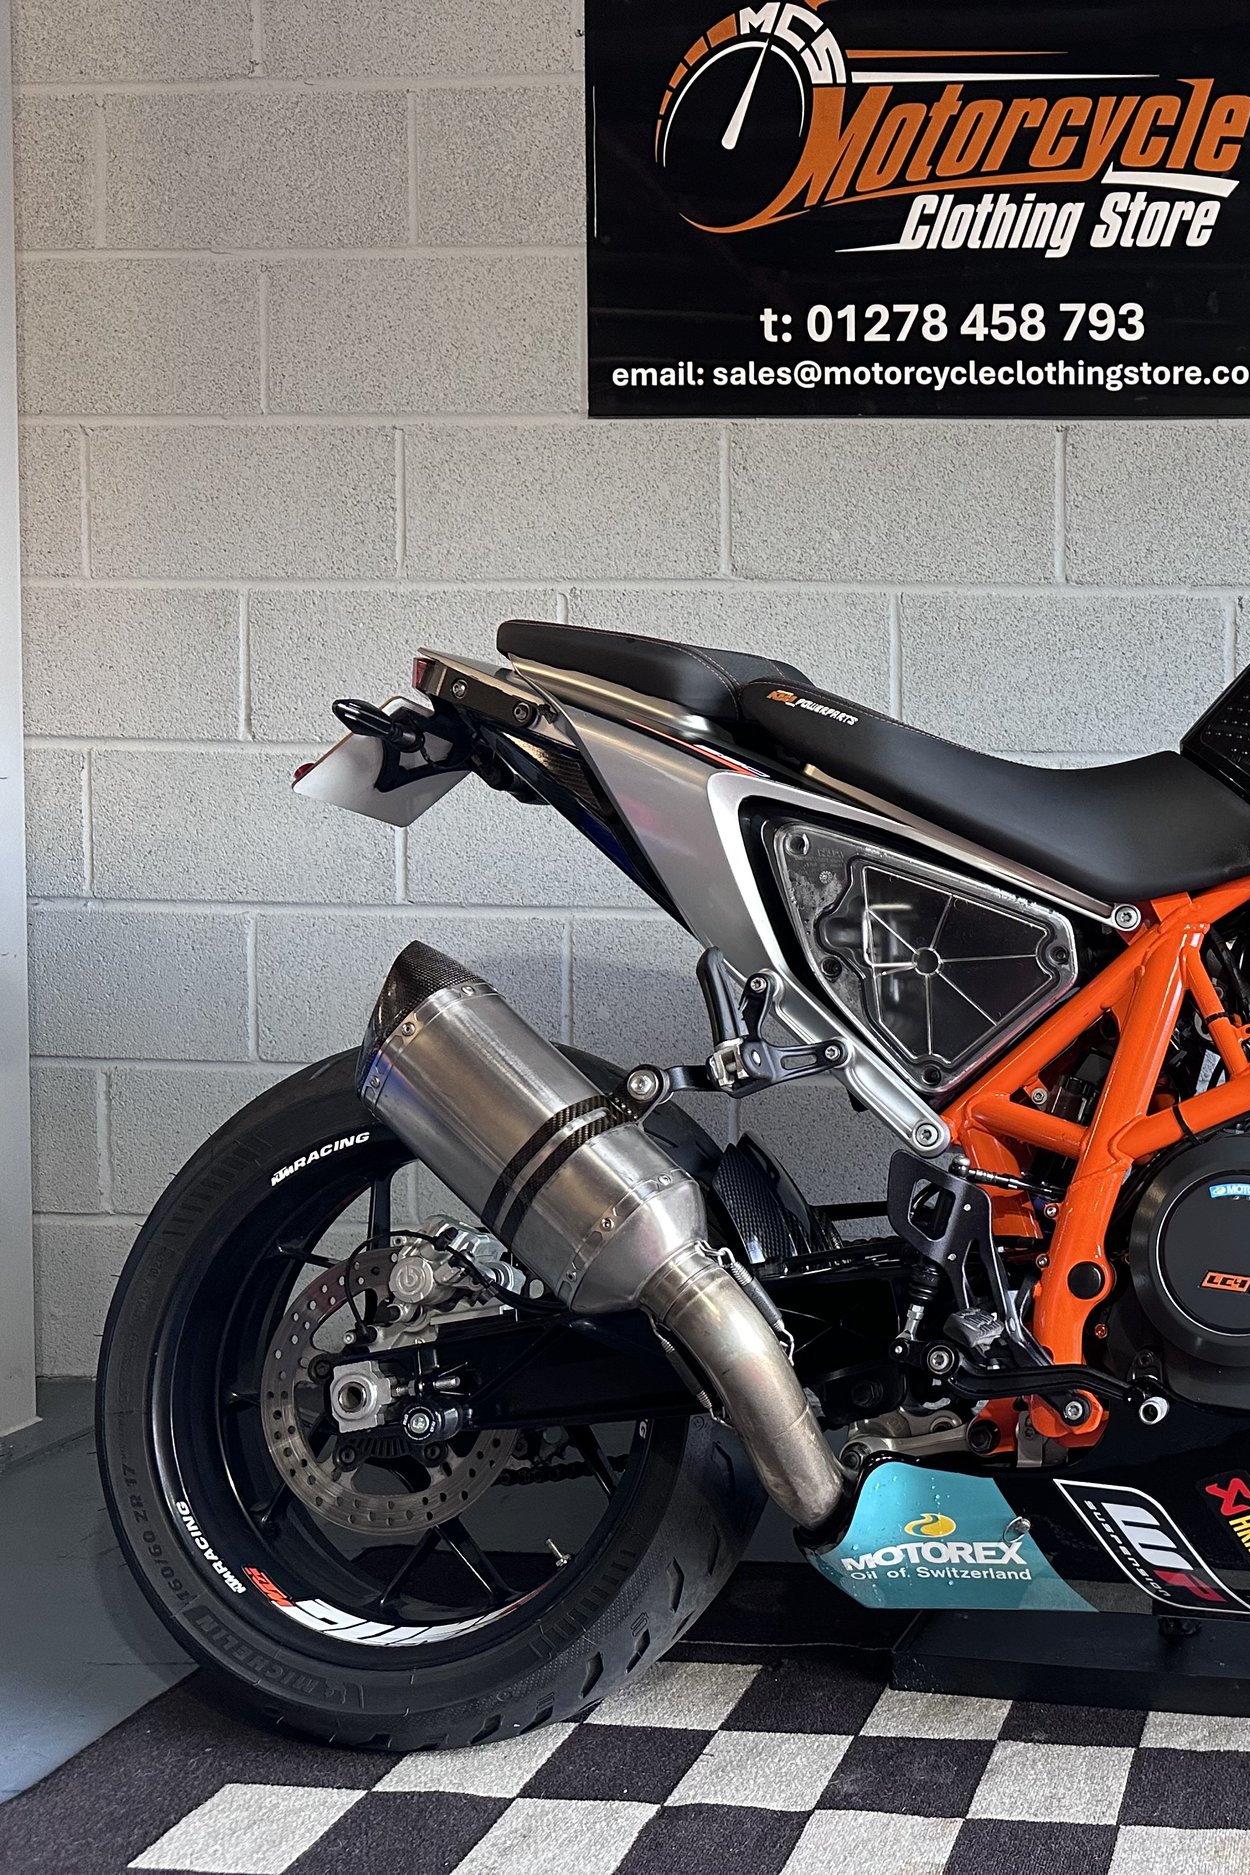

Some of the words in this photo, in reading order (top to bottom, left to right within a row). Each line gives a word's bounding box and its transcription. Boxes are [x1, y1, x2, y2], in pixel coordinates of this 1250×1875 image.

[739, 2, 847, 84] MCS
[900, 193, 1084, 259] Clothing
[1090, 191, 1221, 249] Store
[760, 308, 792, 342] t:
[807, 304, 948, 342] 01278
[960, 303, 1046, 342] 458
[1059, 303, 1145, 342] 793
[612, 361, 705, 387] email:
[796, 699, 859, 726] POWERPARTS
[841, 1541, 1027, 1572] MOTOREX
[1084, 1500, 1171, 1597] SUSPENSION
[851, 1569, 878, 1580] Oil
[917, 1566, 1032, 1581] Switzerland
